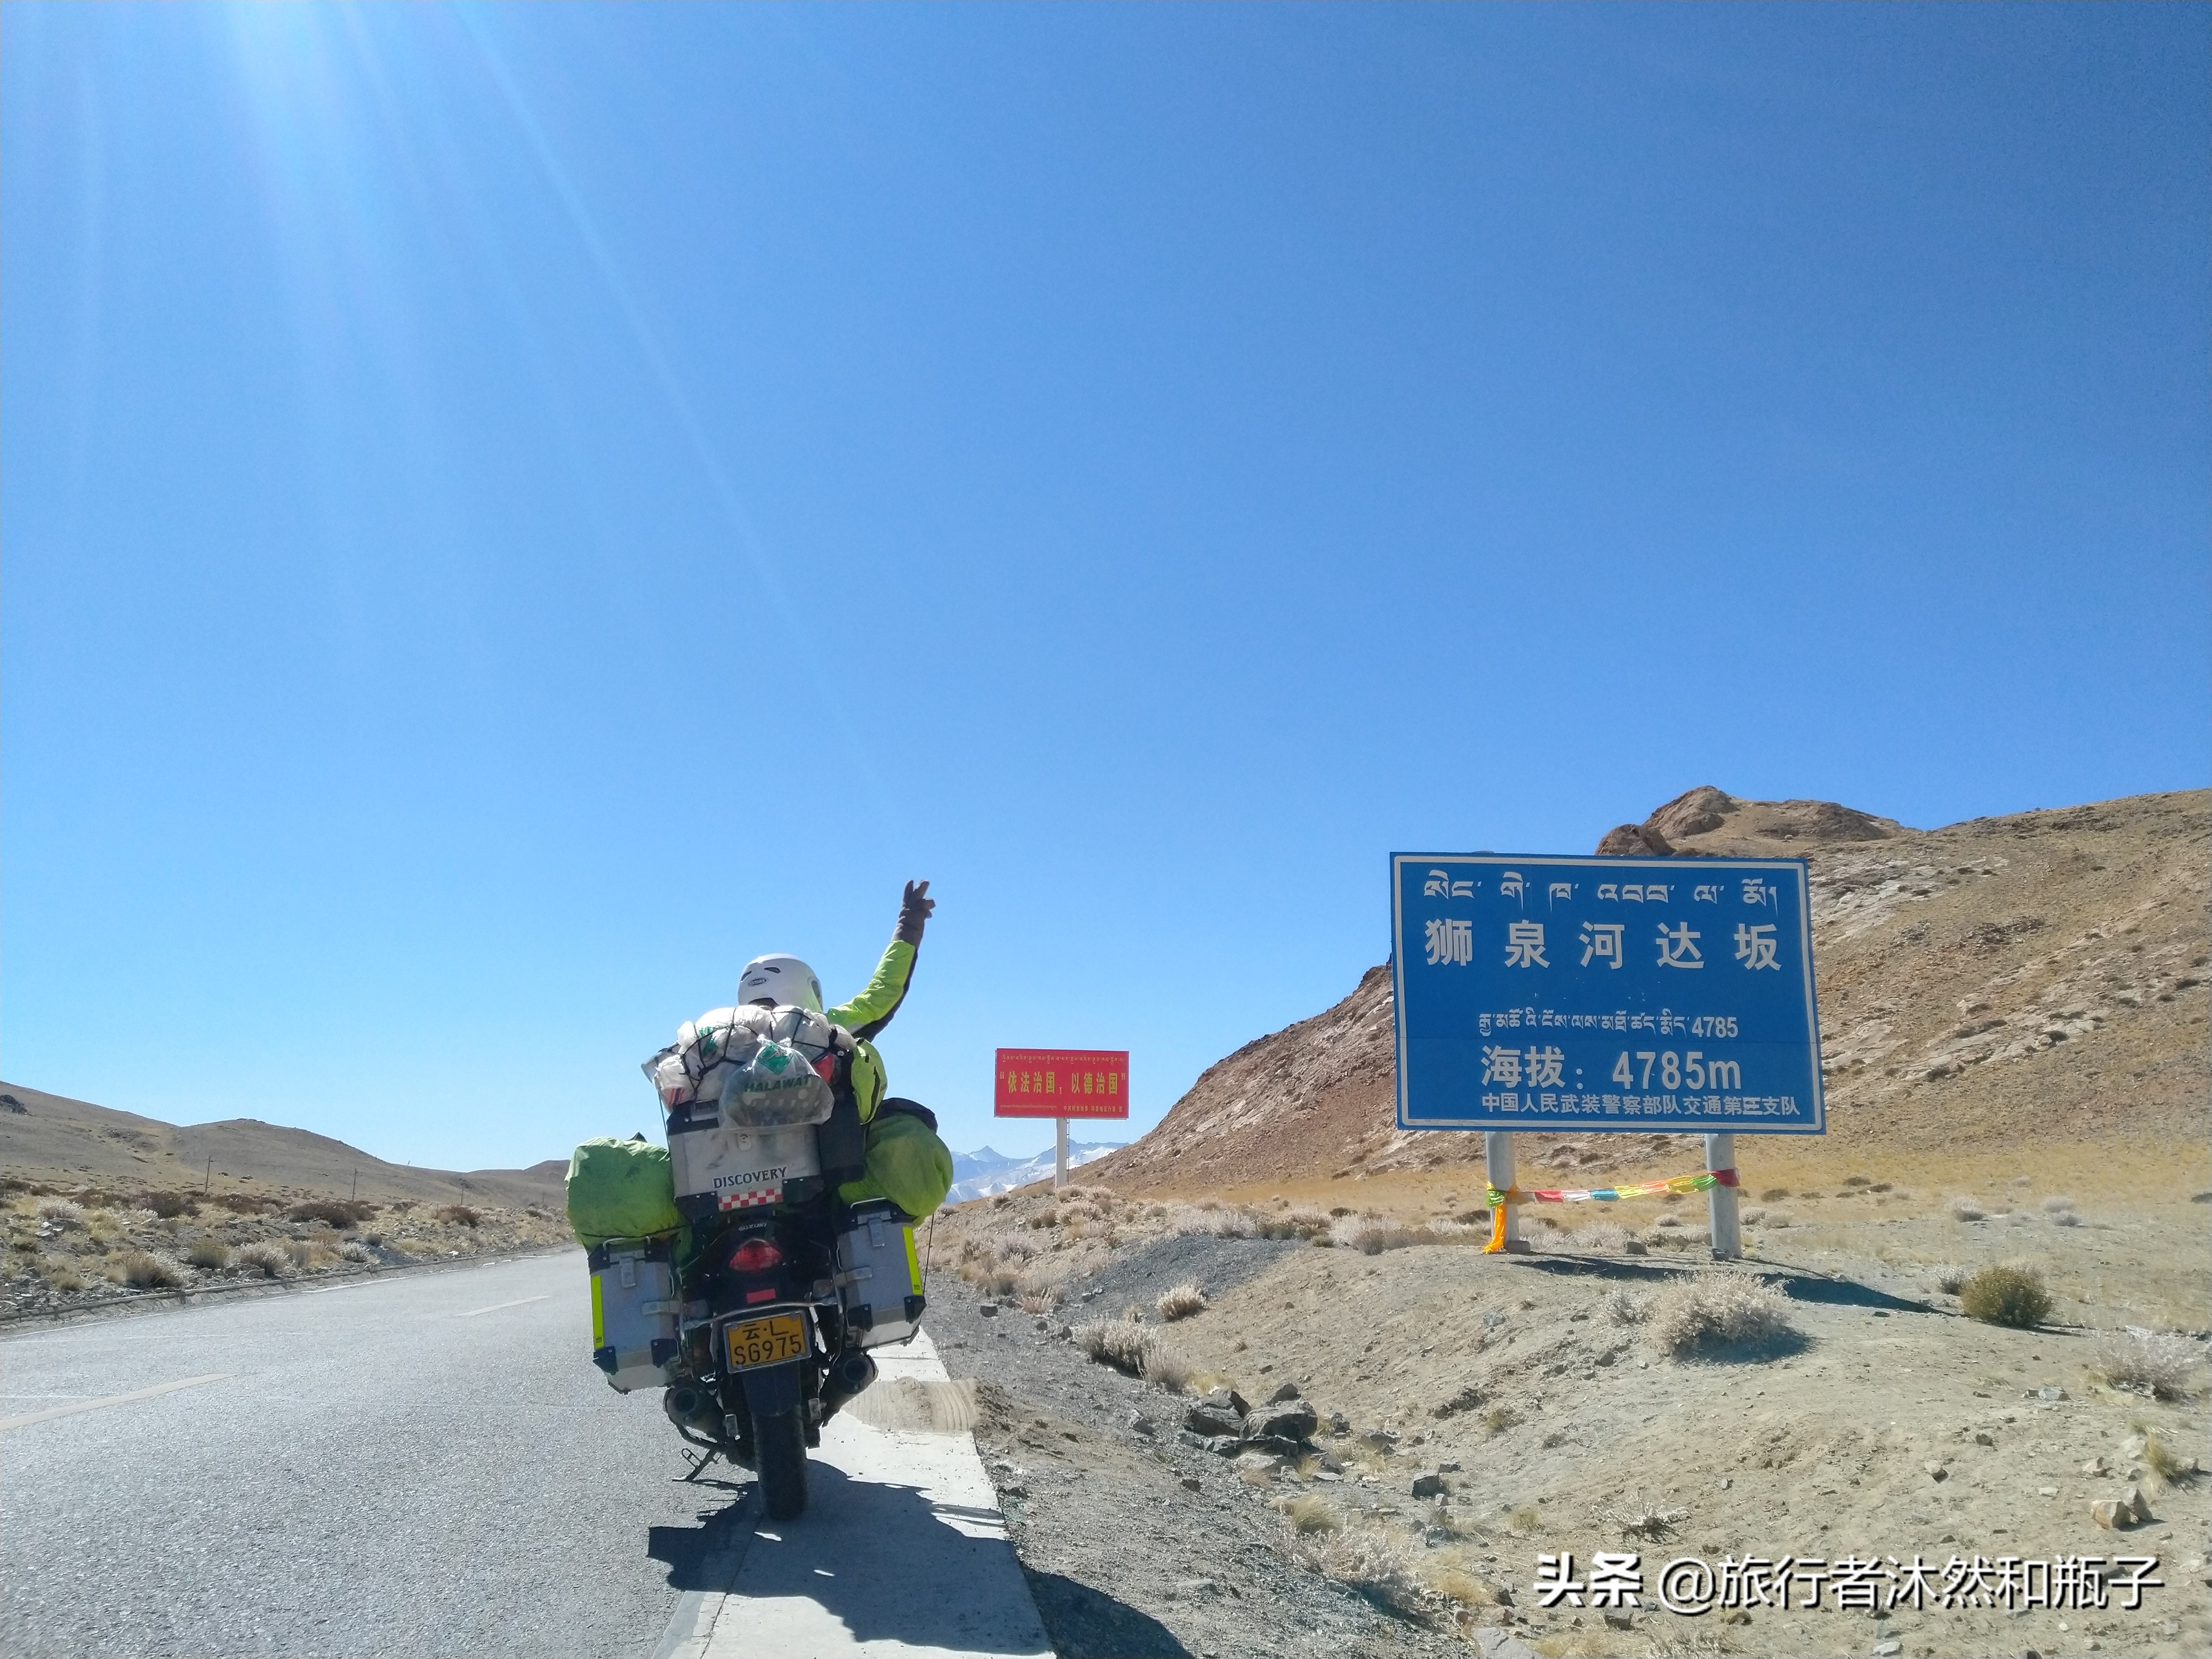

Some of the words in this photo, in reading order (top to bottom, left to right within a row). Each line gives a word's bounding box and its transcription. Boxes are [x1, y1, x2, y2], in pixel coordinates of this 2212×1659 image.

[1424, 919, 1782, 971] 狮泉河达坂
[1692, 1016, 1738, 1038] 4785
[1612, 1050, 1742, 1090] 4785m
[713, 1167, 787, 1189] DISCOVERY
[734, 1334, 802, 1365] SG975
